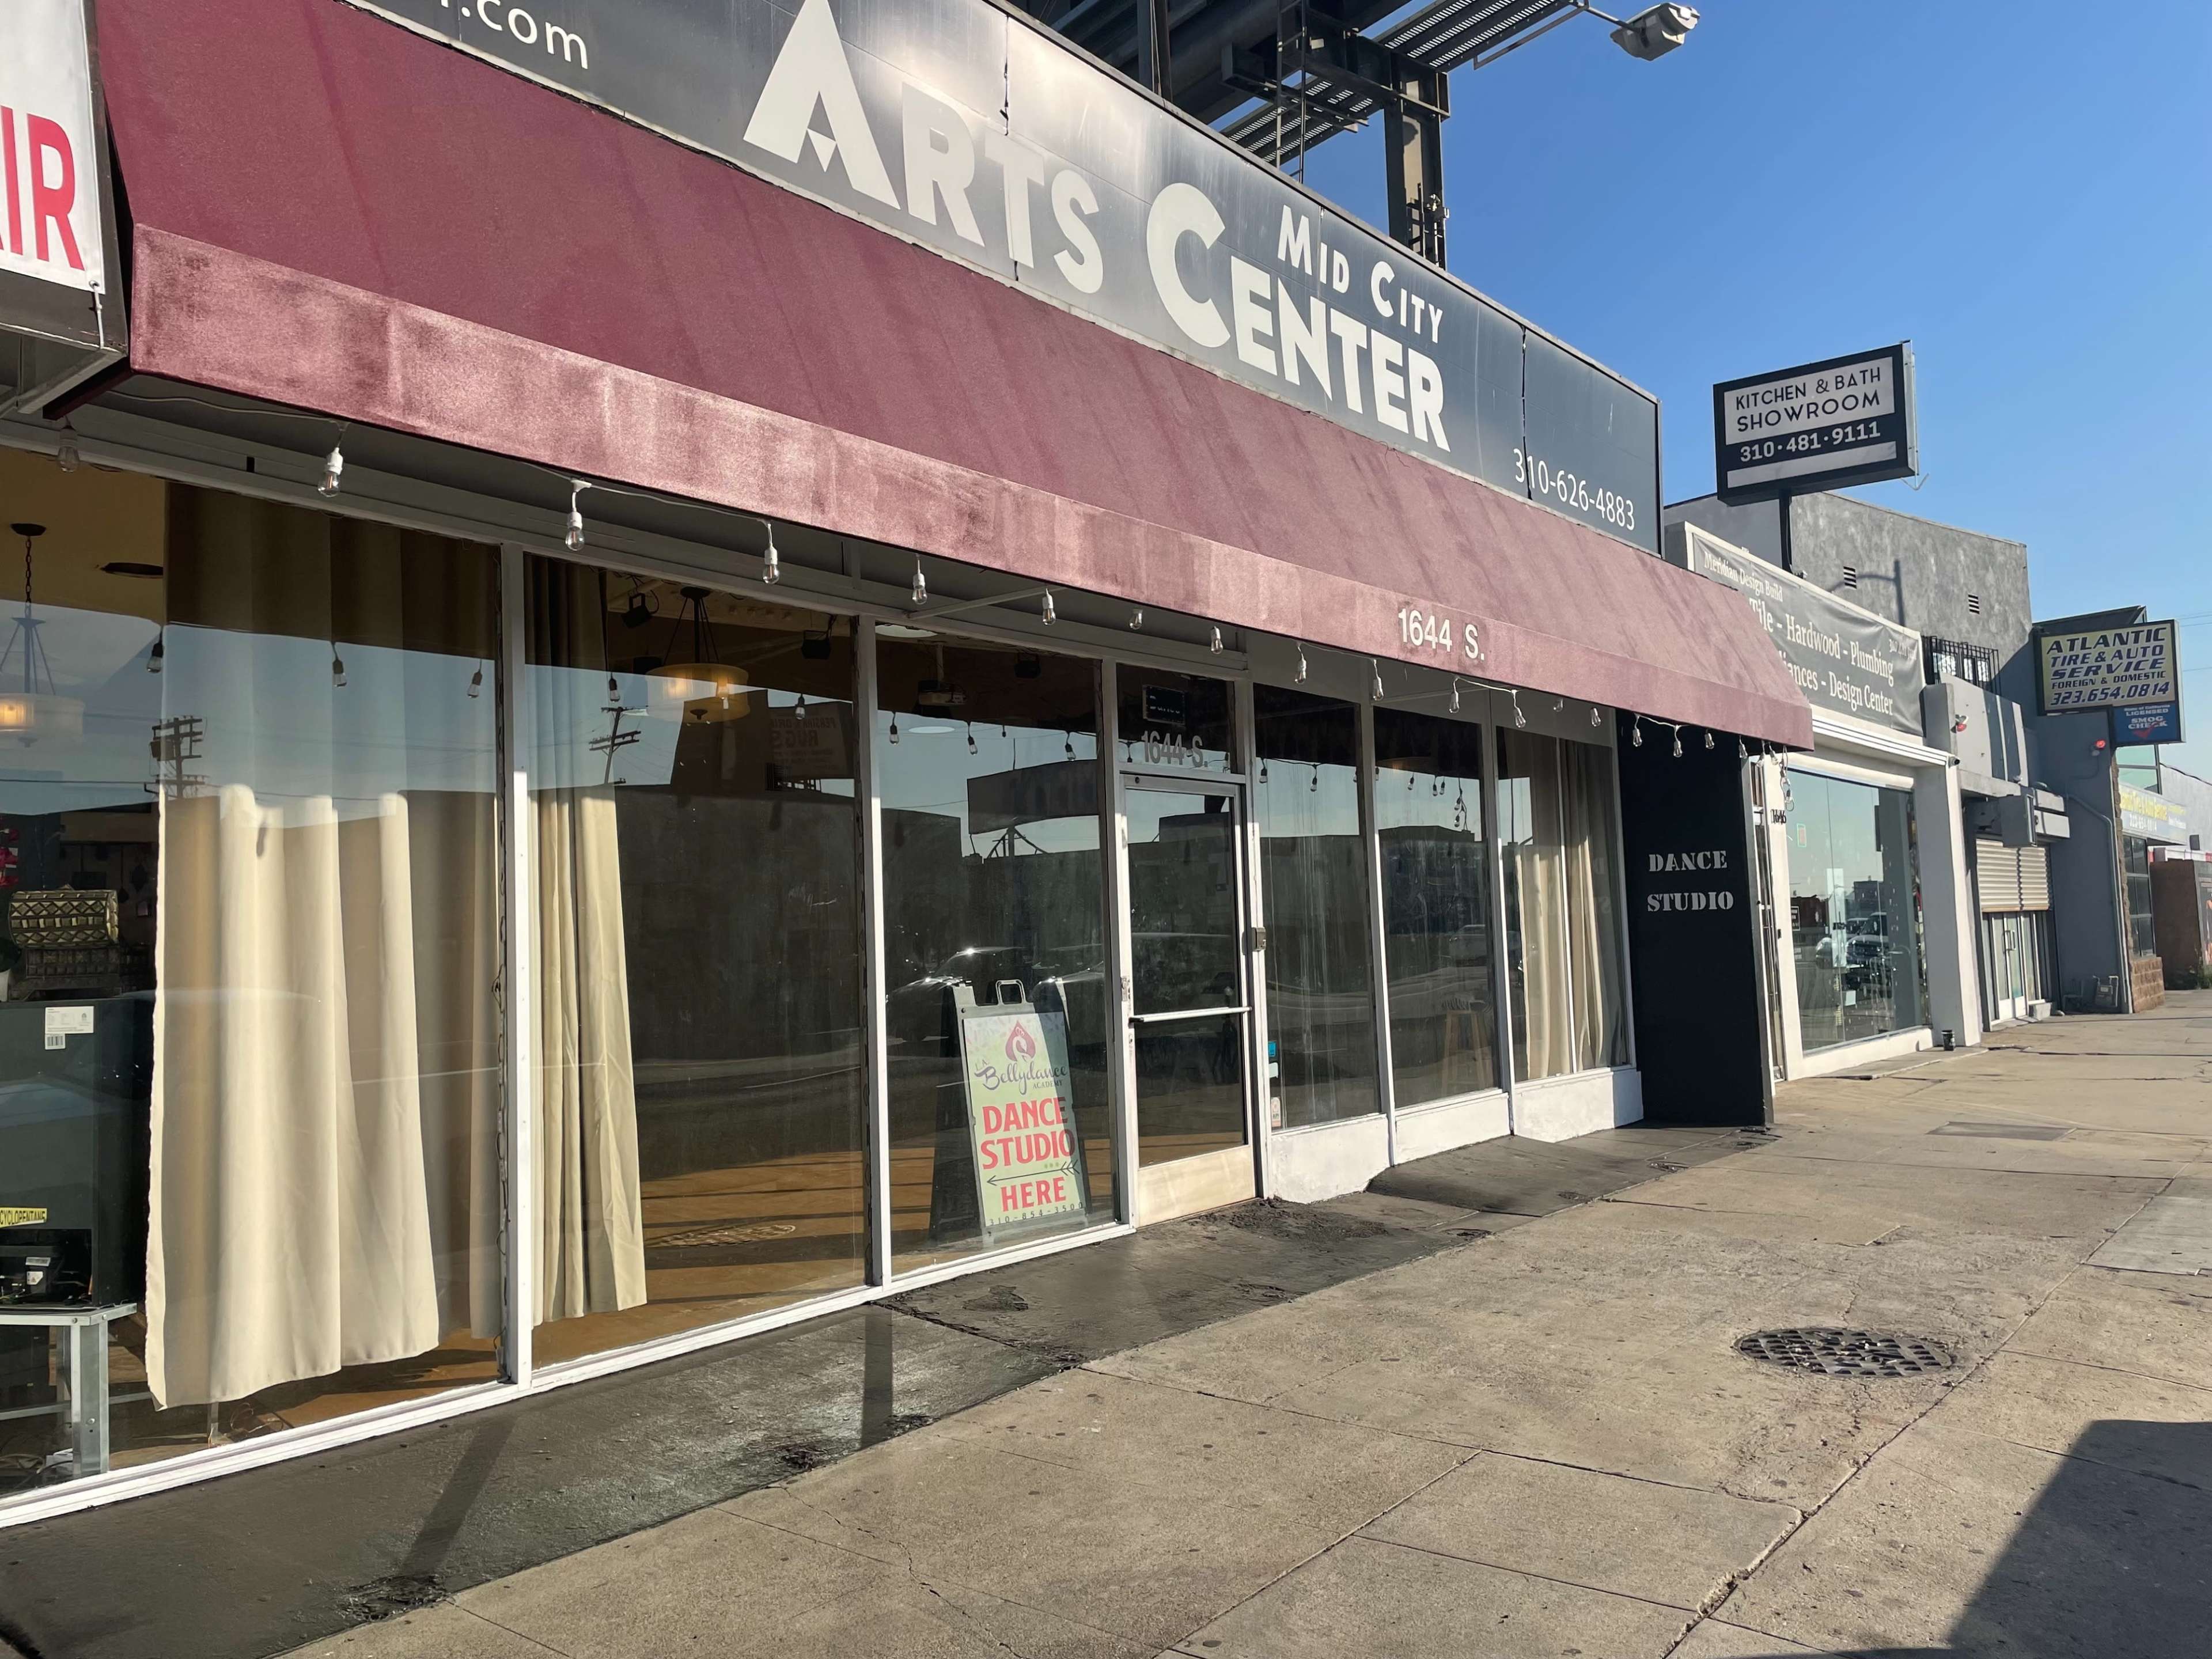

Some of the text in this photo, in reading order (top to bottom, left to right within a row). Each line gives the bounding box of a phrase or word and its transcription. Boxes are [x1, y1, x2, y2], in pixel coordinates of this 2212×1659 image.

[440, 0, 588, 69] .com
[0, 105, 85, 271] IR
[743, 0, 1450, 452] ARTS CENTER
[1278, 204, 1442, 343] MID CITY
[1736, 367, 1881, 410] KITCHEN & BATH
[1737, 389, 1880, 432] SHOWROOM
[1513, 448, 1635, 531] 310-626-4883
[1704, 551, 1783, 602] Meridian Design Build
[1398, 608, 1485, 660] 1644 S.
[1786, 613, 1840, 659] Hardwood
[1850, 641, 1893, 687] Plumbing
[2047, 627, 2166, 654] ATLANTIC
[2051, 645, 2164, 668] TIRE & AUTO
[2051, 658, 2166, 680] SERVICE
[1829, 671, 1863, 711] Design
[1864, 685, 1893, 715] Center
[2050, 681, 2170, 706] 323.654.0814
[2052, 679, 2096, 690] FOREIGN
[2113, 671, 2166, 683] DOMESTIC
[2128, 721, 2168, 729] CHECK
[2131, 715, 2164, 724] SMOG
[1141, 730, 1208, 768] 1644 S.
[1649, 850, 1728, 872] DANCE
[1647, 891, 1734, 912] STUDIO
[974, 1061, 1067, 1095] Bellydance
[1032, 1080, 1063, 1089] ACADEMY
[982, 1097, 1068, 1134] DANCE
[980, 1129, 1075, 1169] STUDIO
[1001, 1176, 1067, 1212] HERE
